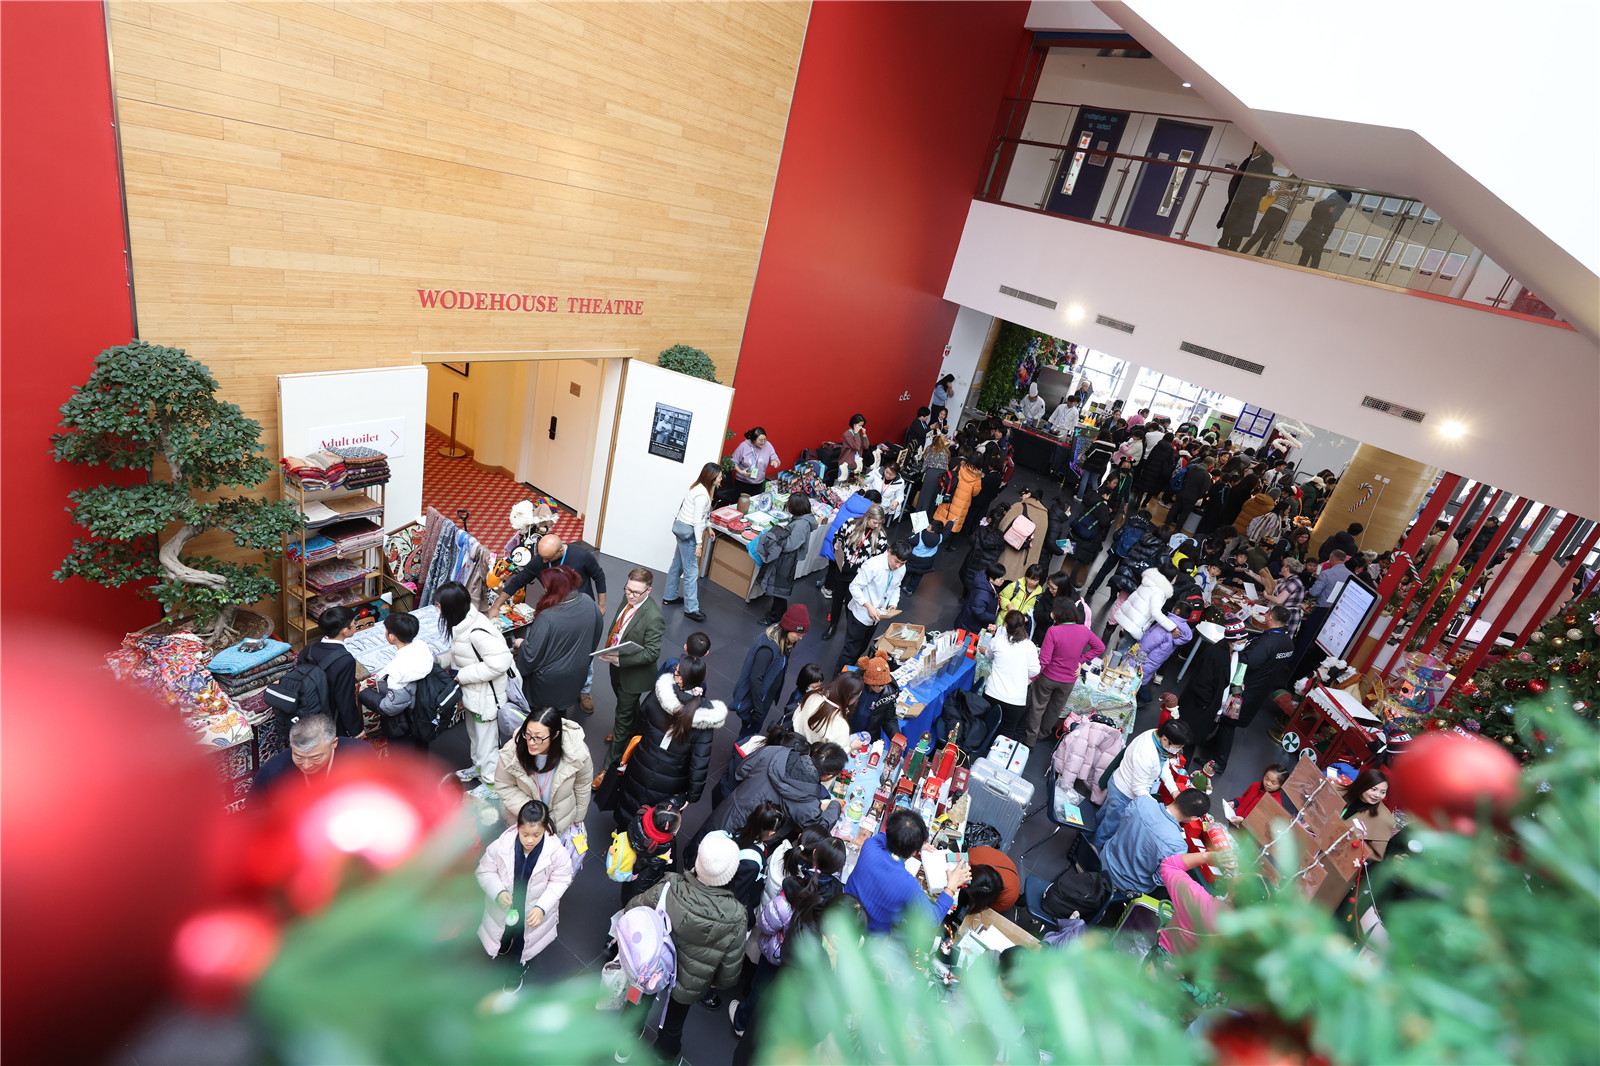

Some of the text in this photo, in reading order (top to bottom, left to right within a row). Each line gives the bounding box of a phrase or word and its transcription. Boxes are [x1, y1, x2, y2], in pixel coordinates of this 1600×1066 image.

[417, 289, 644, 315] WODEHOUSE THEATRE
[319, 433, 379, 449] Adult toilet
